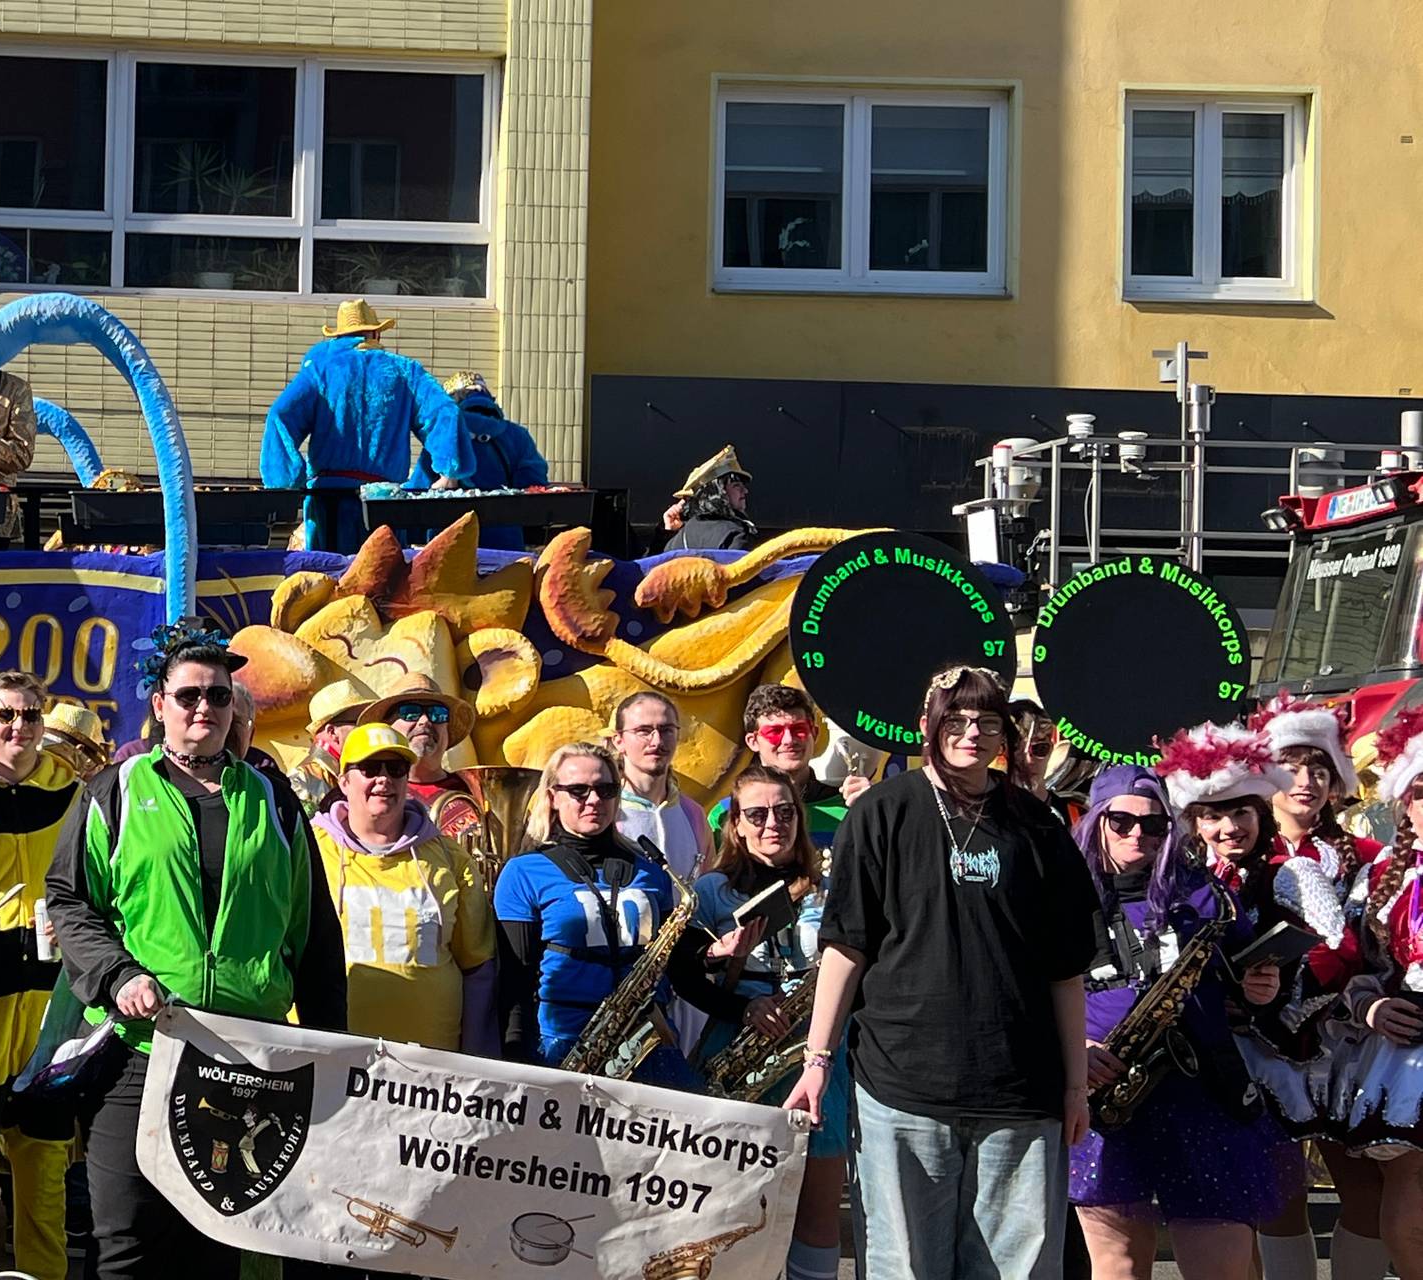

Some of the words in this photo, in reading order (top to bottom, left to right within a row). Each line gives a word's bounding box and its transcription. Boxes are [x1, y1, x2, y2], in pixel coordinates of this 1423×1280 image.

[1307, 559, 1344, 580] Neusser
[802, 551, 870, 635] Drumband
[873, 548, 889, 565] &
[894, 547, 995, 624] Musikkorps
[1037, 556, 1132, 628] Drumband
[1138, 557, 1154, 576] &
[1160, 562, 1243, 665] Musikkorps
[802, 652, 825, 669] 19
[983, 640, 1006, 657] 97
[1218, 681, 1245, 701] 97
[855, 710, 924, 745] Wölfer
[1056, 717, 1163, 768] Wölfershe
[198, 1066, 295, 1092] WÖLFERSHEIM
[231, 1086, 259, 1099] 1997
[344, 1066, 528, 1126] Drumband
[539, 1099, 562, 1130] &
[576, 1103, 779, 1171] Musikkorps
[175, 1094, 215, 1191] DRUMBAND
[220, 1197, 235, 1211] &
[244, 1112, 305, 1199] MUSIKKORPS
[398, 1134, 611, 1198] Wölfersheim
[625, 1173, 713, 1214] 1997
